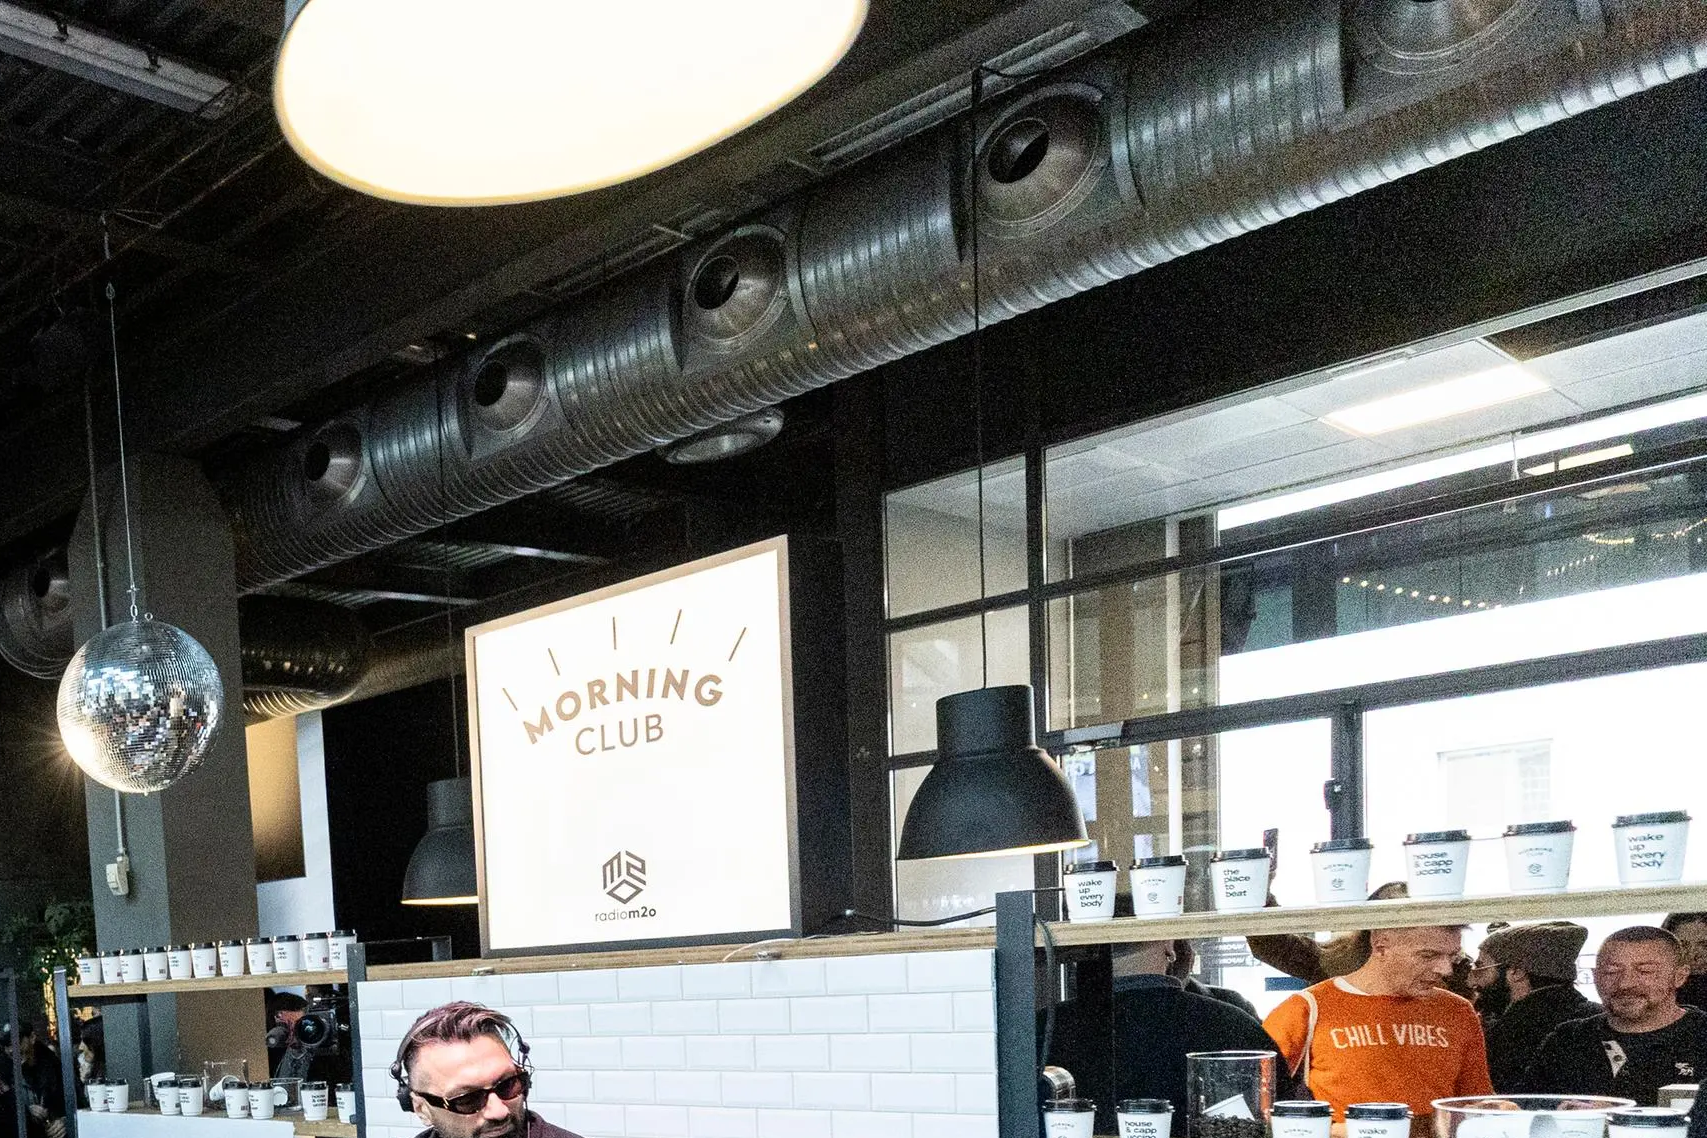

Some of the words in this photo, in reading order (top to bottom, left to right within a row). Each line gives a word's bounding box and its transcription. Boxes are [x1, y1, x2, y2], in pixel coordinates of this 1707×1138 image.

[523, 667, 723, 745] MORNING
[575, 713, 664, 756] CLUB
[595, 905, 657, 922] radiom2o
[1330, 1023, 1389, 1049] CHILL
[1392, 1023, 1449, 1048] VIBES
